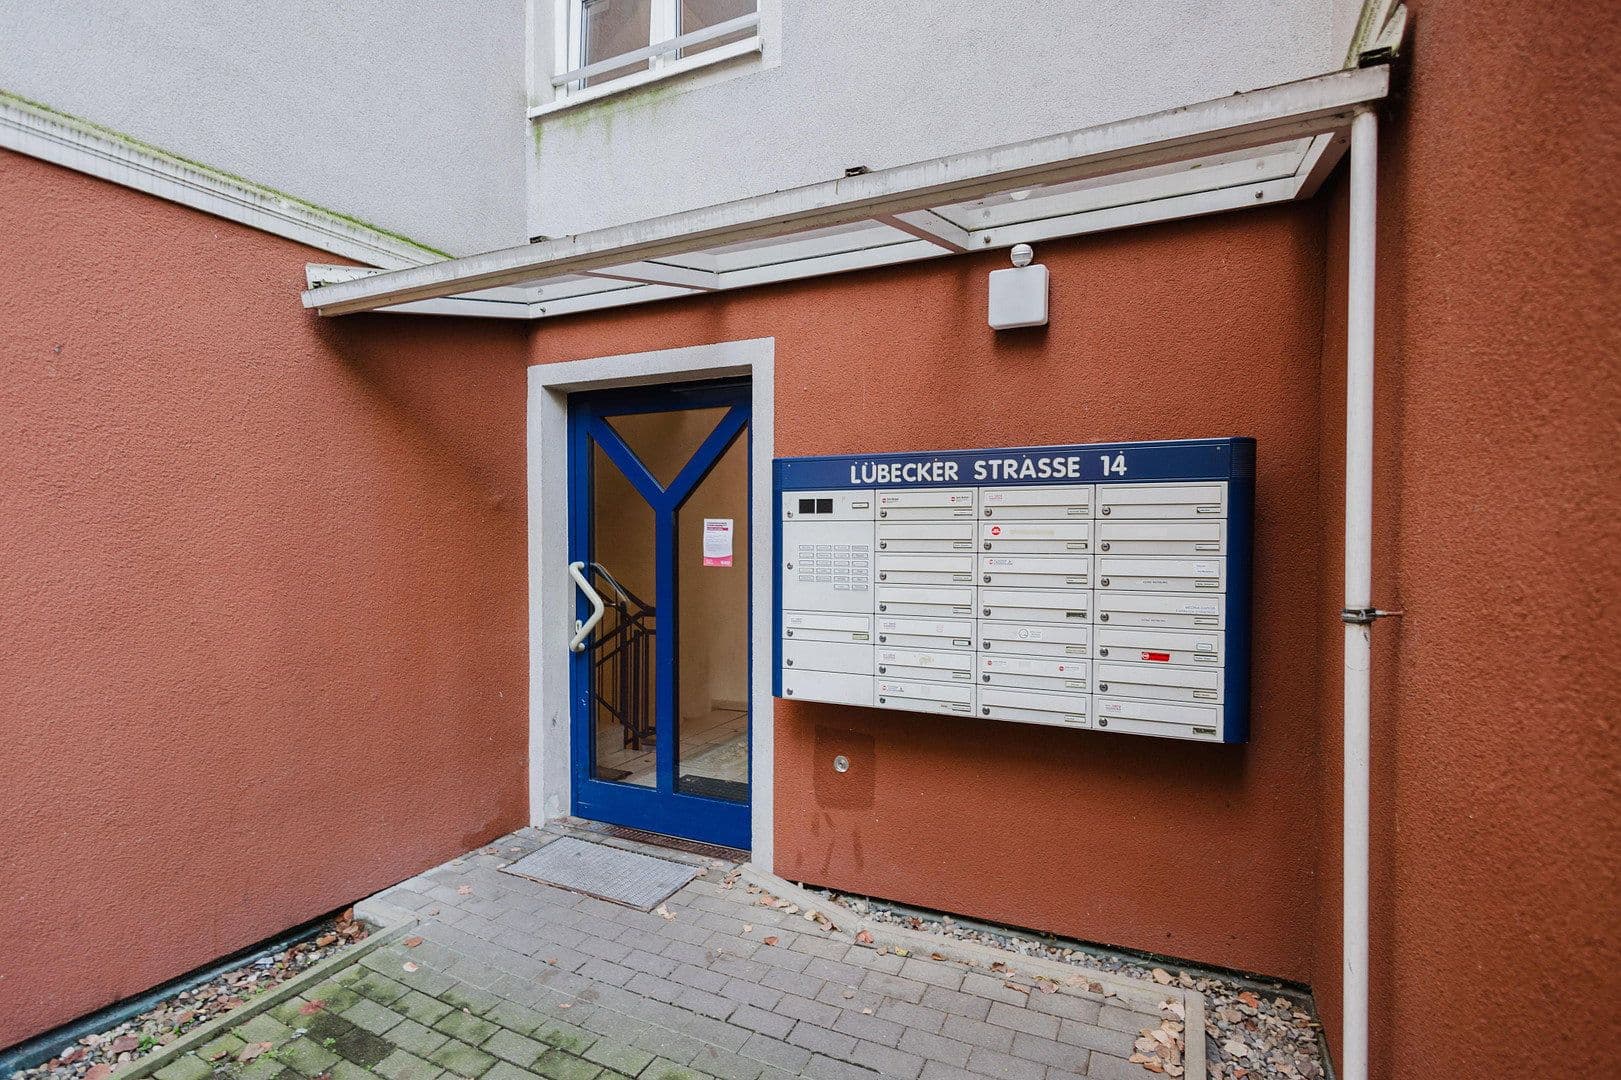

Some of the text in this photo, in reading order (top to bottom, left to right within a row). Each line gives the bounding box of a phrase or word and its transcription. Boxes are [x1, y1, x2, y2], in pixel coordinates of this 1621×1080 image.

[850, 454, 1127, 484] LÜBECKER STRASSE 14
